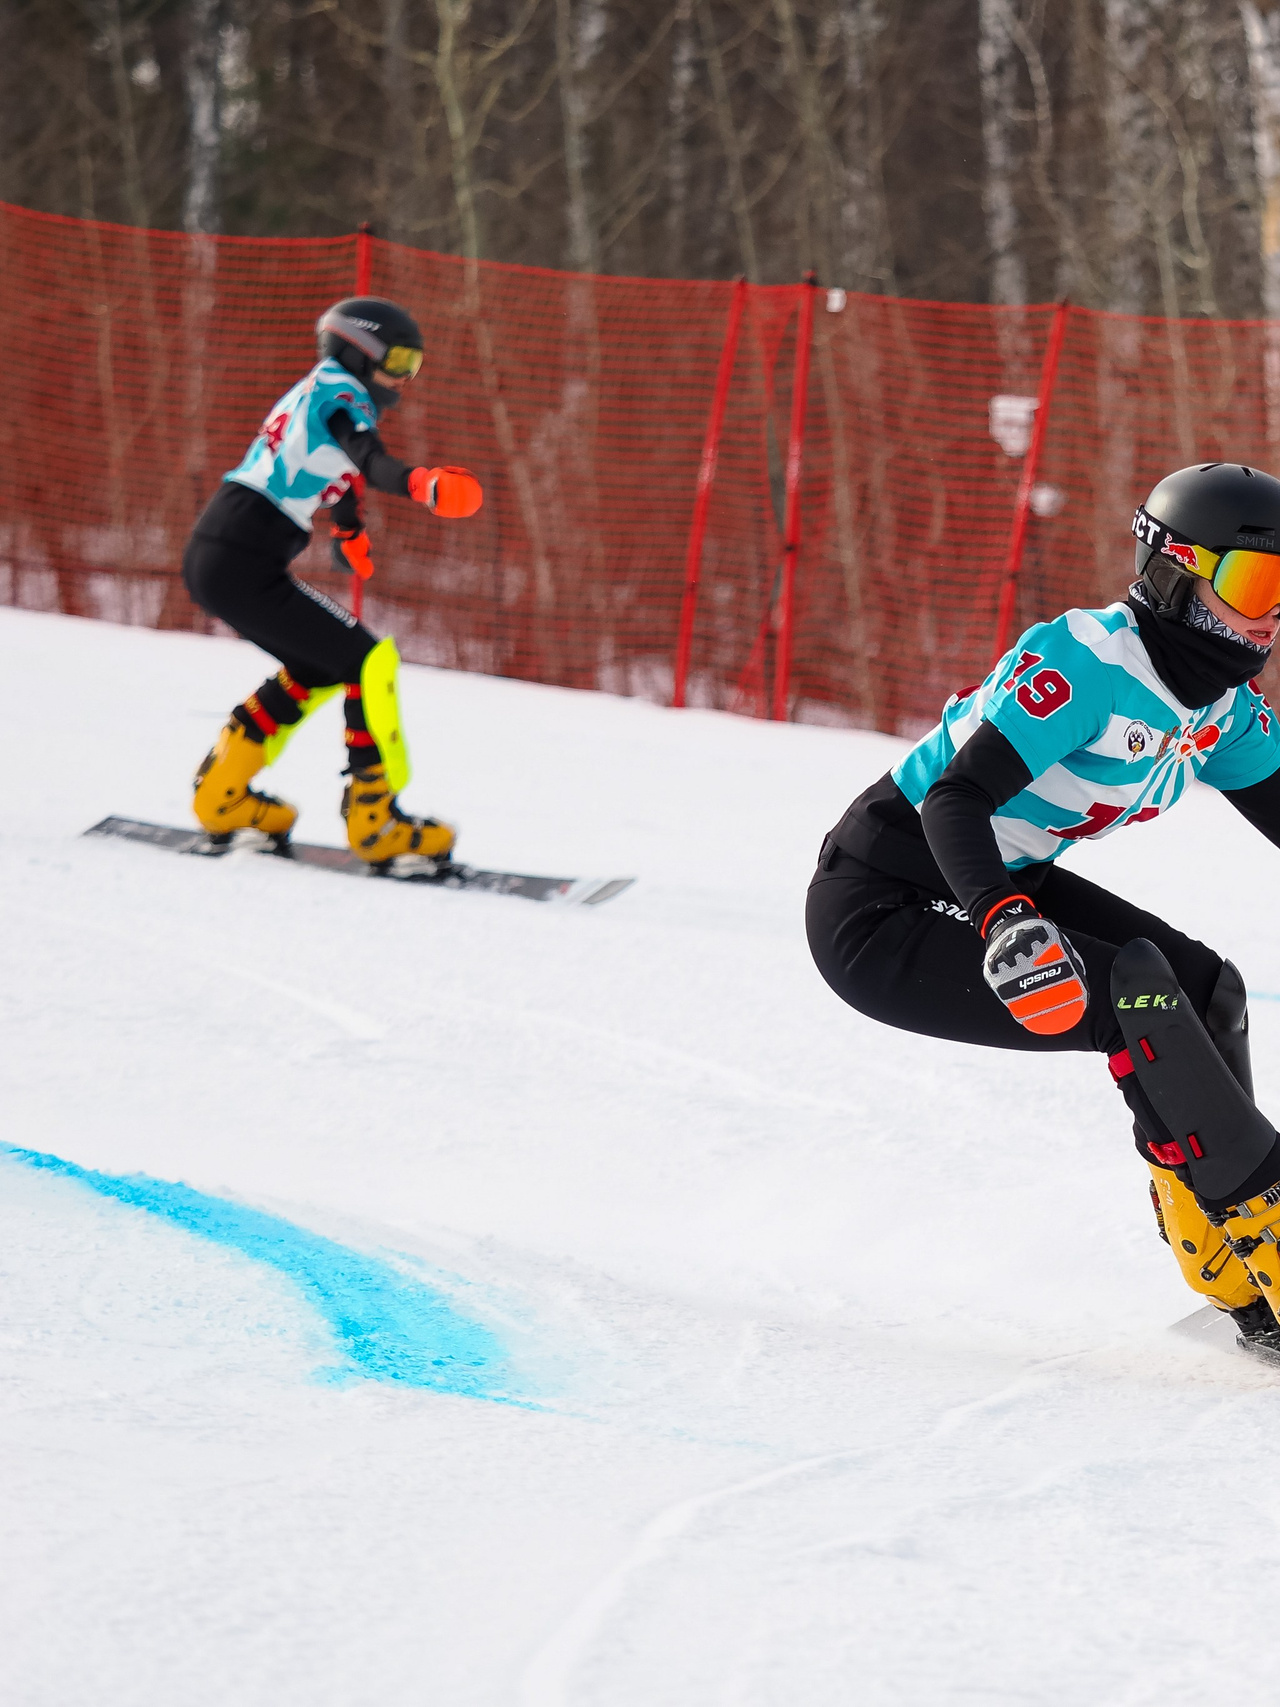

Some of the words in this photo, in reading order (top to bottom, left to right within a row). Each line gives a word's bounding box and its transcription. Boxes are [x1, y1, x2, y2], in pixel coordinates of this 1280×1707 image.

[1236, 535, 1275, 548] SMITH
[1003, 650, 1072, 719] 19
[1019, 966, 1062, 990] reusch
